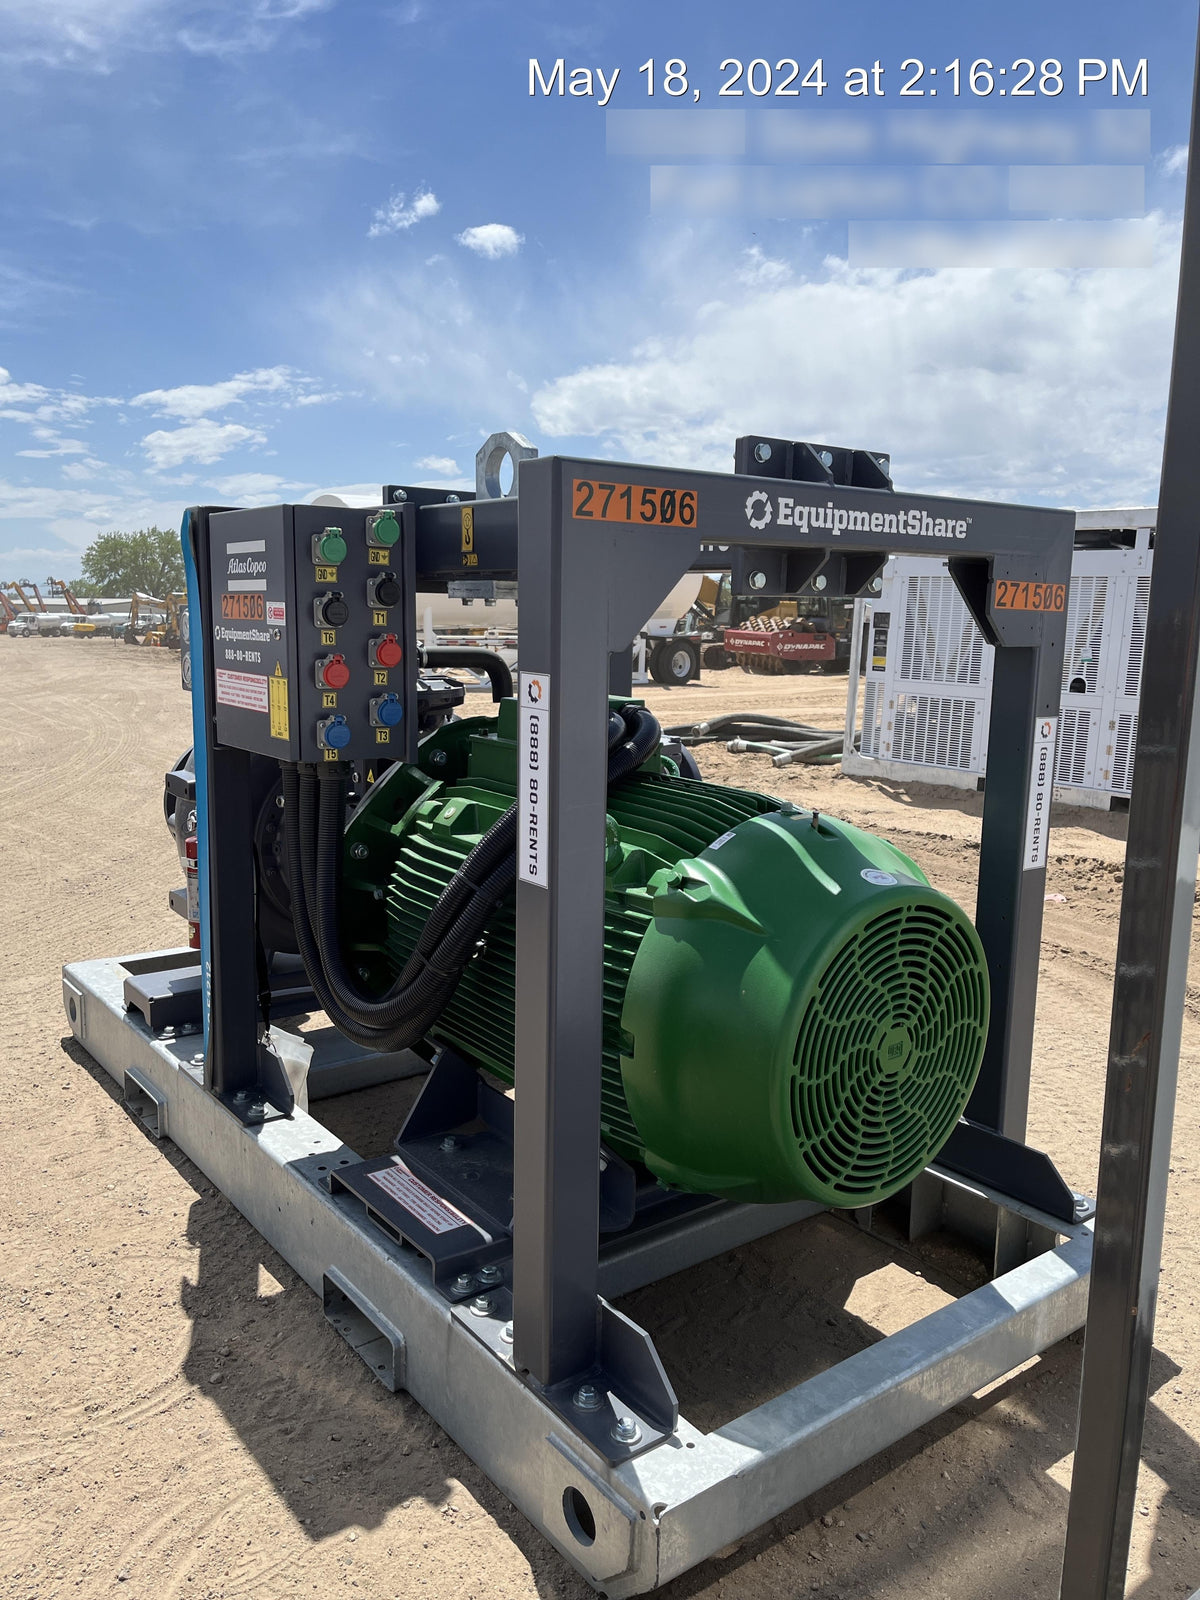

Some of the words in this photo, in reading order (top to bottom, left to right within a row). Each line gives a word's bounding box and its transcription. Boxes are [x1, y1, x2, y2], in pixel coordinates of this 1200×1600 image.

[575, 481, 695, 525] 271506
[370, 551, 380, 562] GND
[227, 558, 246, 575] Atlas
[246, 557, 267, 576] Copco
[317, 569, 328, 578] GND
[997, 581, 1065, 611] 271506
[222, 595, 263, 619] 271506
[376, 613, 385, 624] T1
[323, 632, 334, 643] T6
[735, 639, 765, 647] DYNAPAC
[376, 672, 386, 683] T2
[325, 695, 335, 706] T4
[378, 730, 388, 741] T3
[529, 714, 540, 771] (888)
[326, 748, 337, 758] T5
[1037, 747, 1048, 787] (888)
[528, 778, 539, 876] 80-RENTS
[1031, 792, 1044, 863] 80-RENTS
